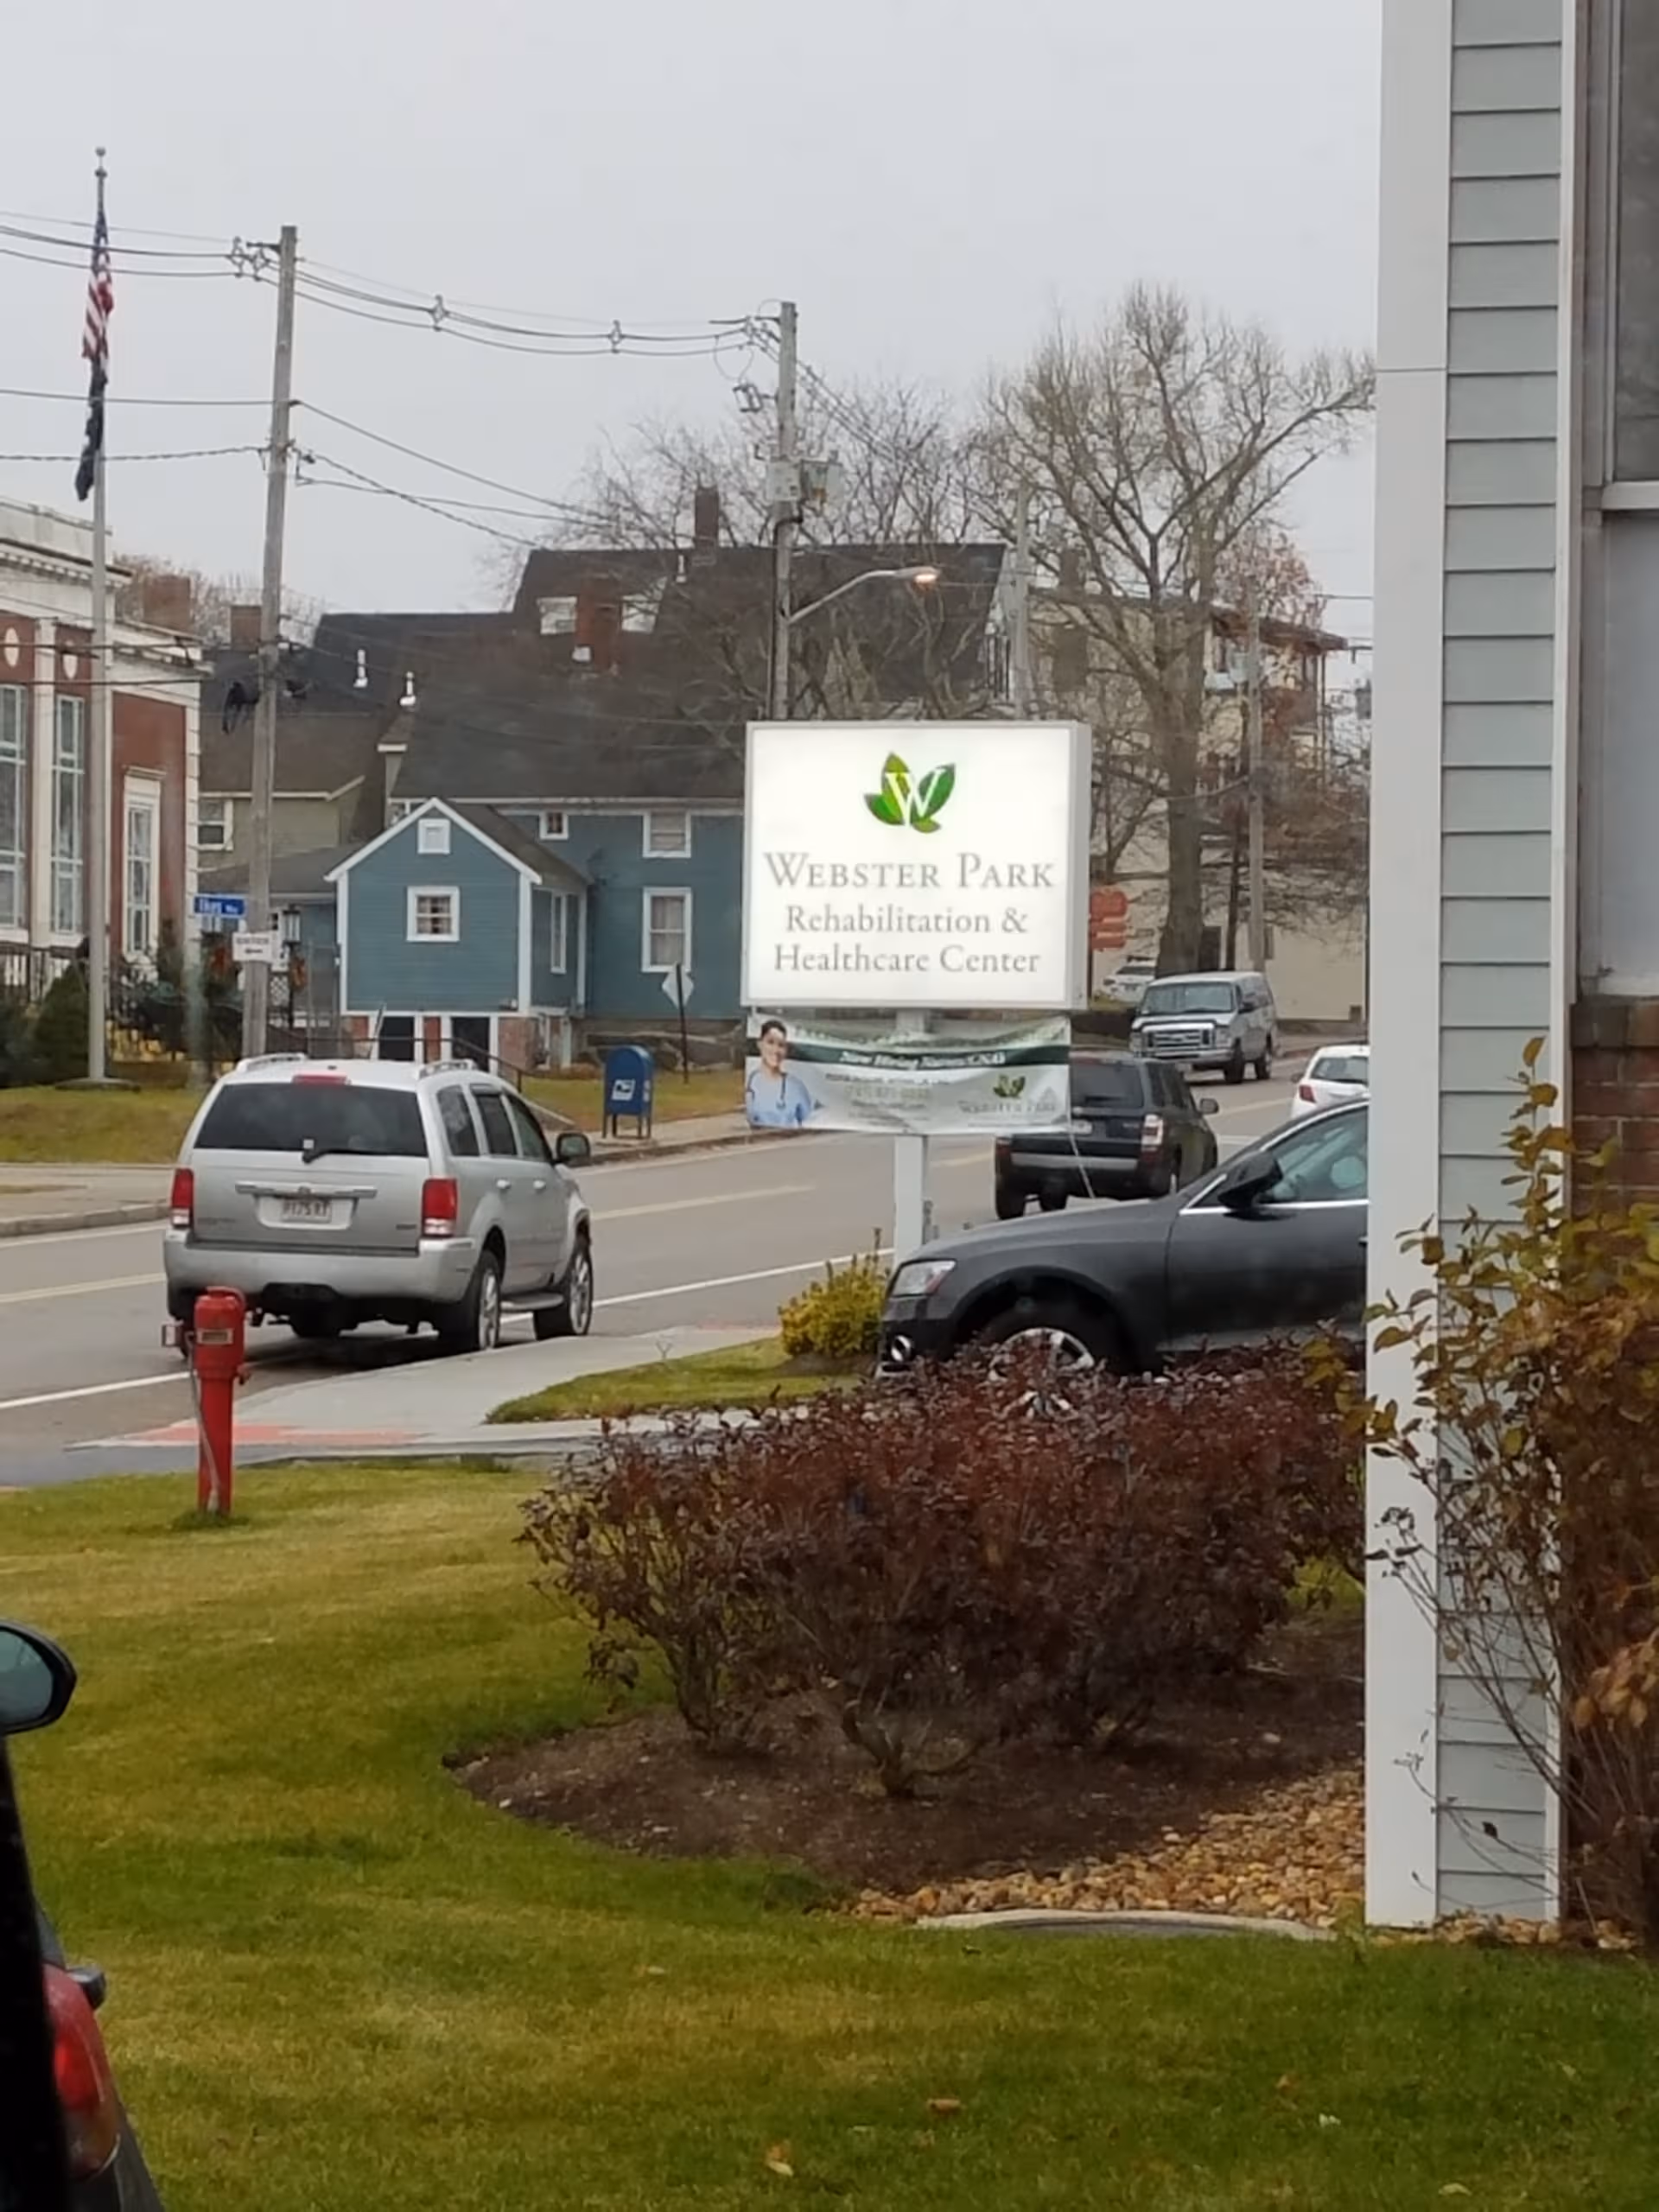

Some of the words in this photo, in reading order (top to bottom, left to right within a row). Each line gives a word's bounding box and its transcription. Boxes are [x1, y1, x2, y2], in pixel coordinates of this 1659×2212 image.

[884, 767, 949, 829] W
[763, 852, 941, 888] WEBSTER
[958, 852, 1055, 888] PARK
[785, 904, 991, 933] Rehabilitation
[1001, 906, 1028, 934] &
[774, 943, 930, 972] Healthcare
[939, 944, 1041, 973] Center
